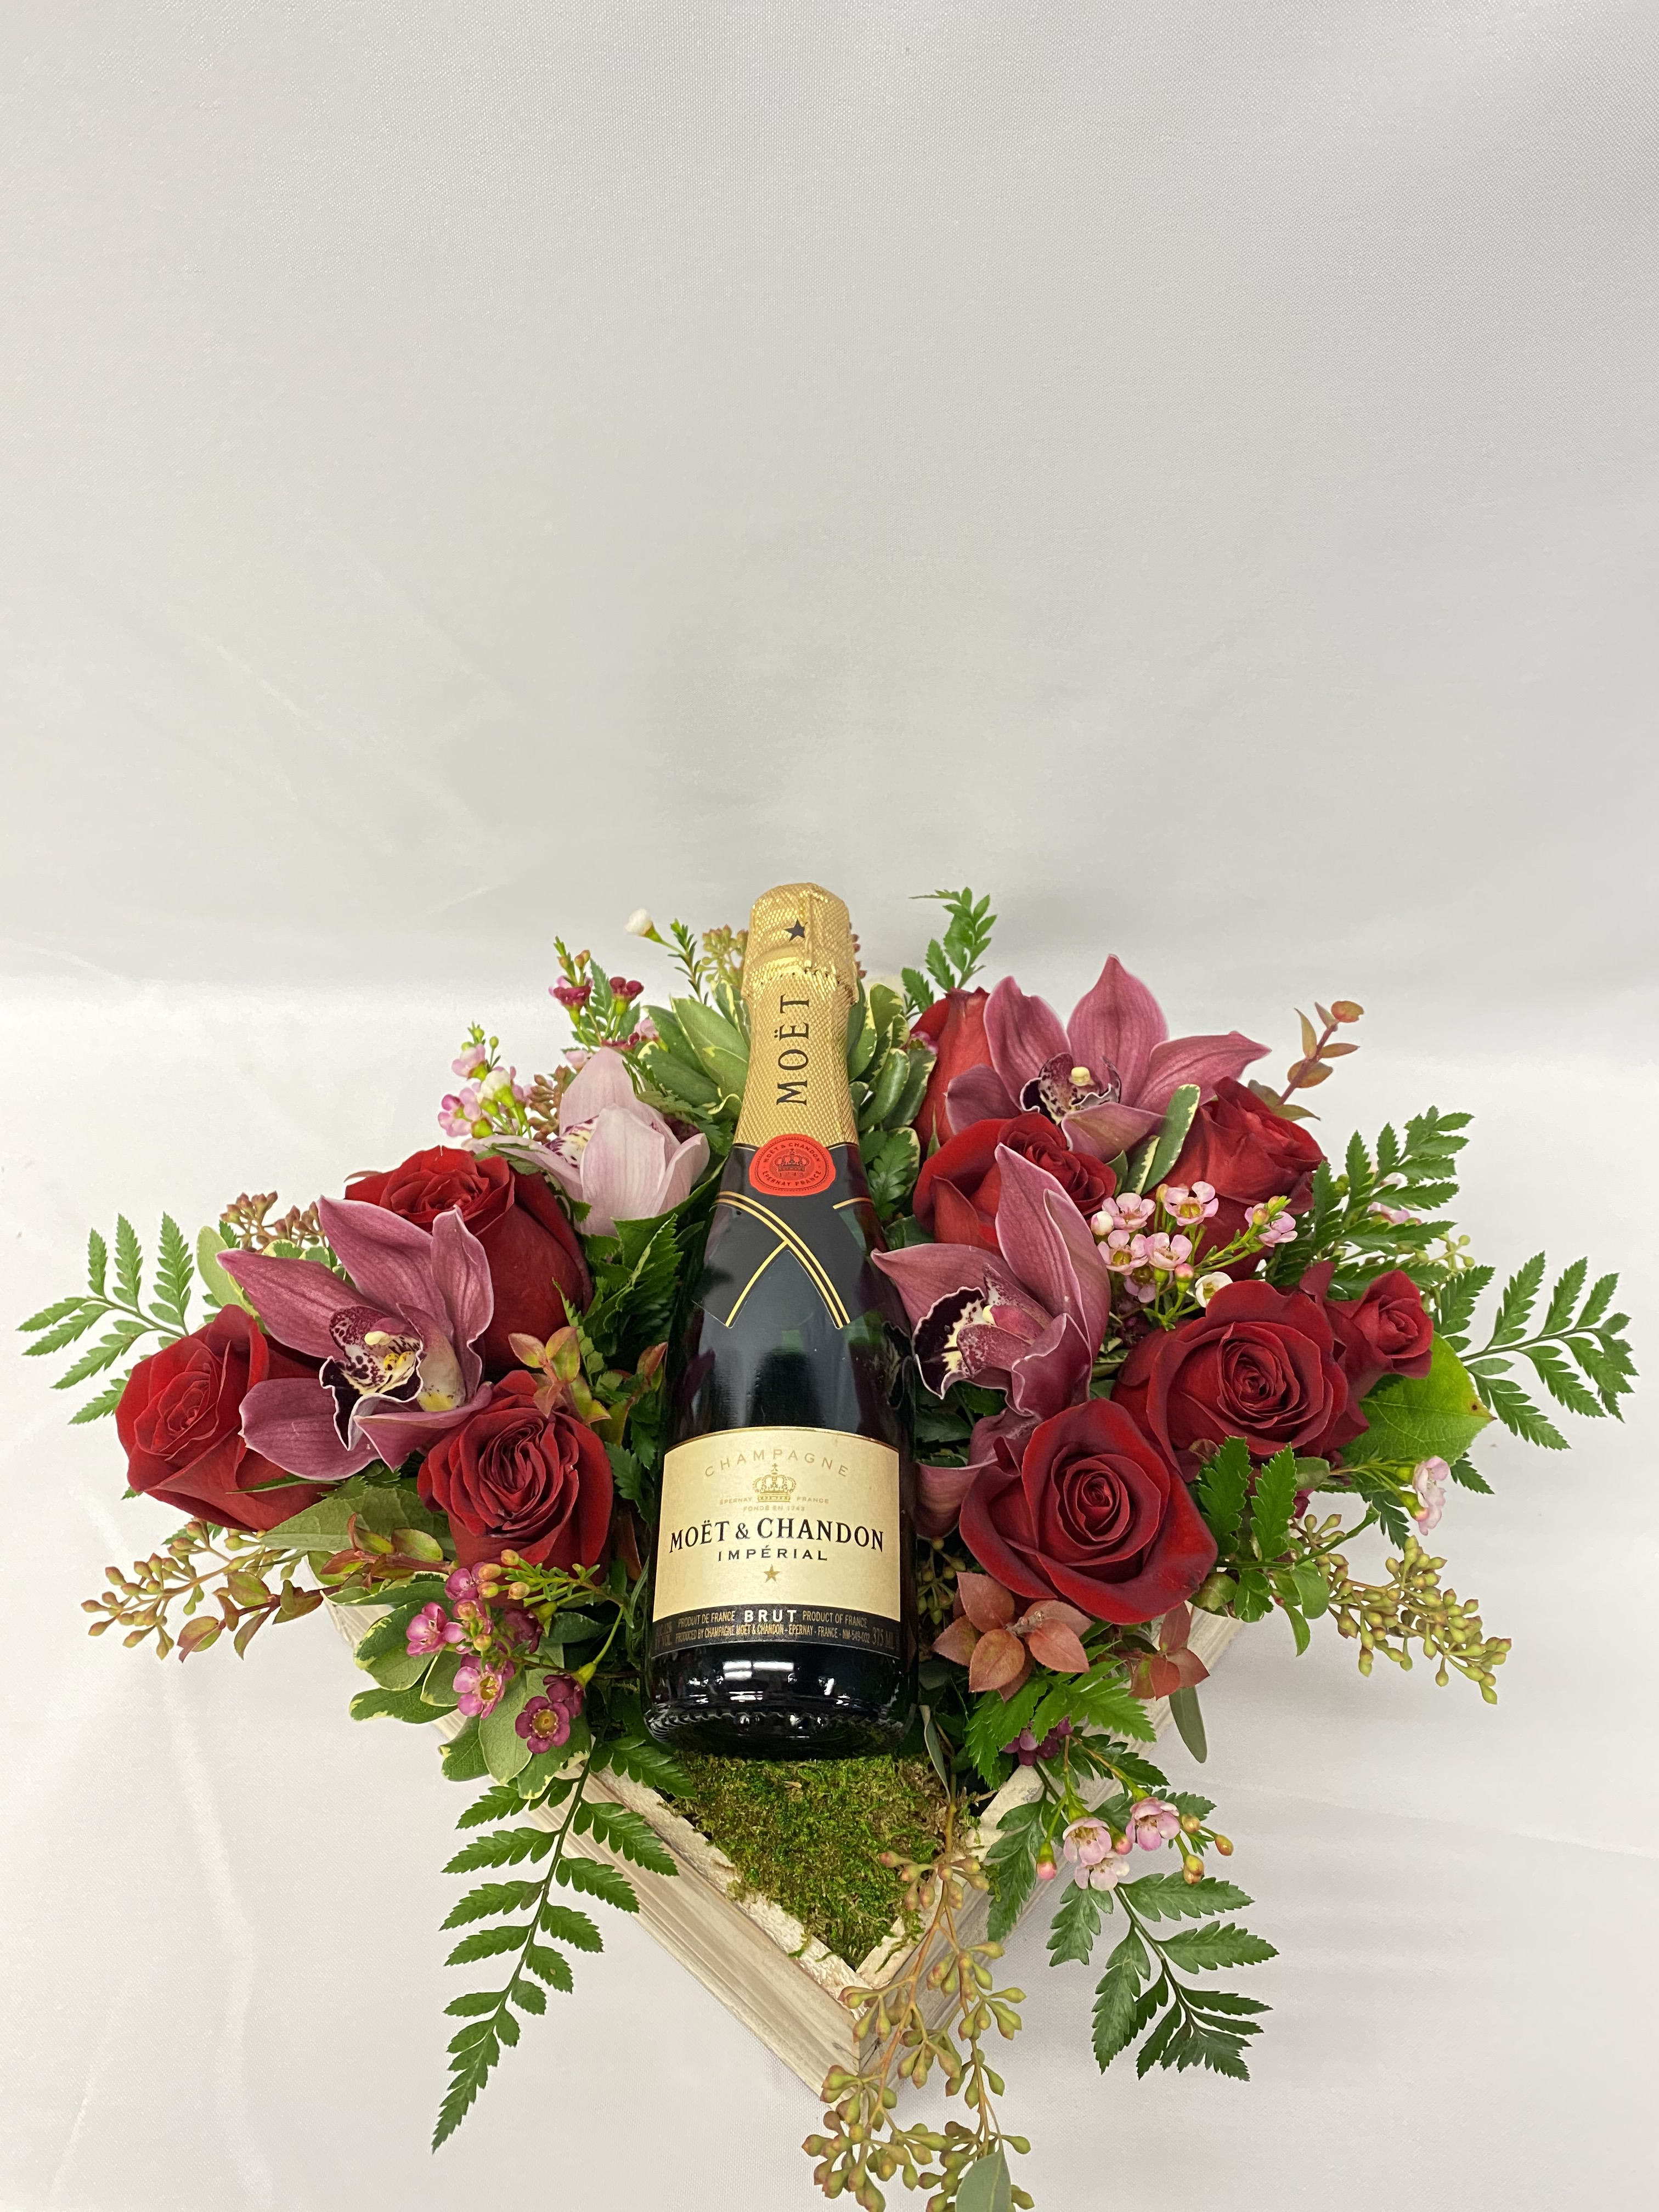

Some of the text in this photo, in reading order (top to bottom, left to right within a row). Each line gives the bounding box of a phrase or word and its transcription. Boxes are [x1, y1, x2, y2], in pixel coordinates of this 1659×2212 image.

[774, 994, 809, 1106] MOËT
[789, 1142, 821, 1161] CHANDON
[795, 1171, 821, 1186] FRANCE
[705, 1449, 848, 1477] CHAMPAGNE
[669, 1517, 884, 1553] MOËT & CHANDON
[718, 1545, 827, 1561] IMPÉRIAL
[678, 1610, 736, 1628] PRODUIT DE FRANCE
[744, 1609, 797, 1623] BRUT
[803, 1610, 867, 1628] PRODUCT OF FRANCE
[676, 1629, 697, 1644] PRODUCED
[698, 1628, 704, 1639] BY
[705, 1625, 736, 1638] CHAMPAGNE
[752, 1624, 756, 1635] &
[757, 1623, 784, 1635] CHANDON
[817, 1626, 838, 1638] FRANCE
